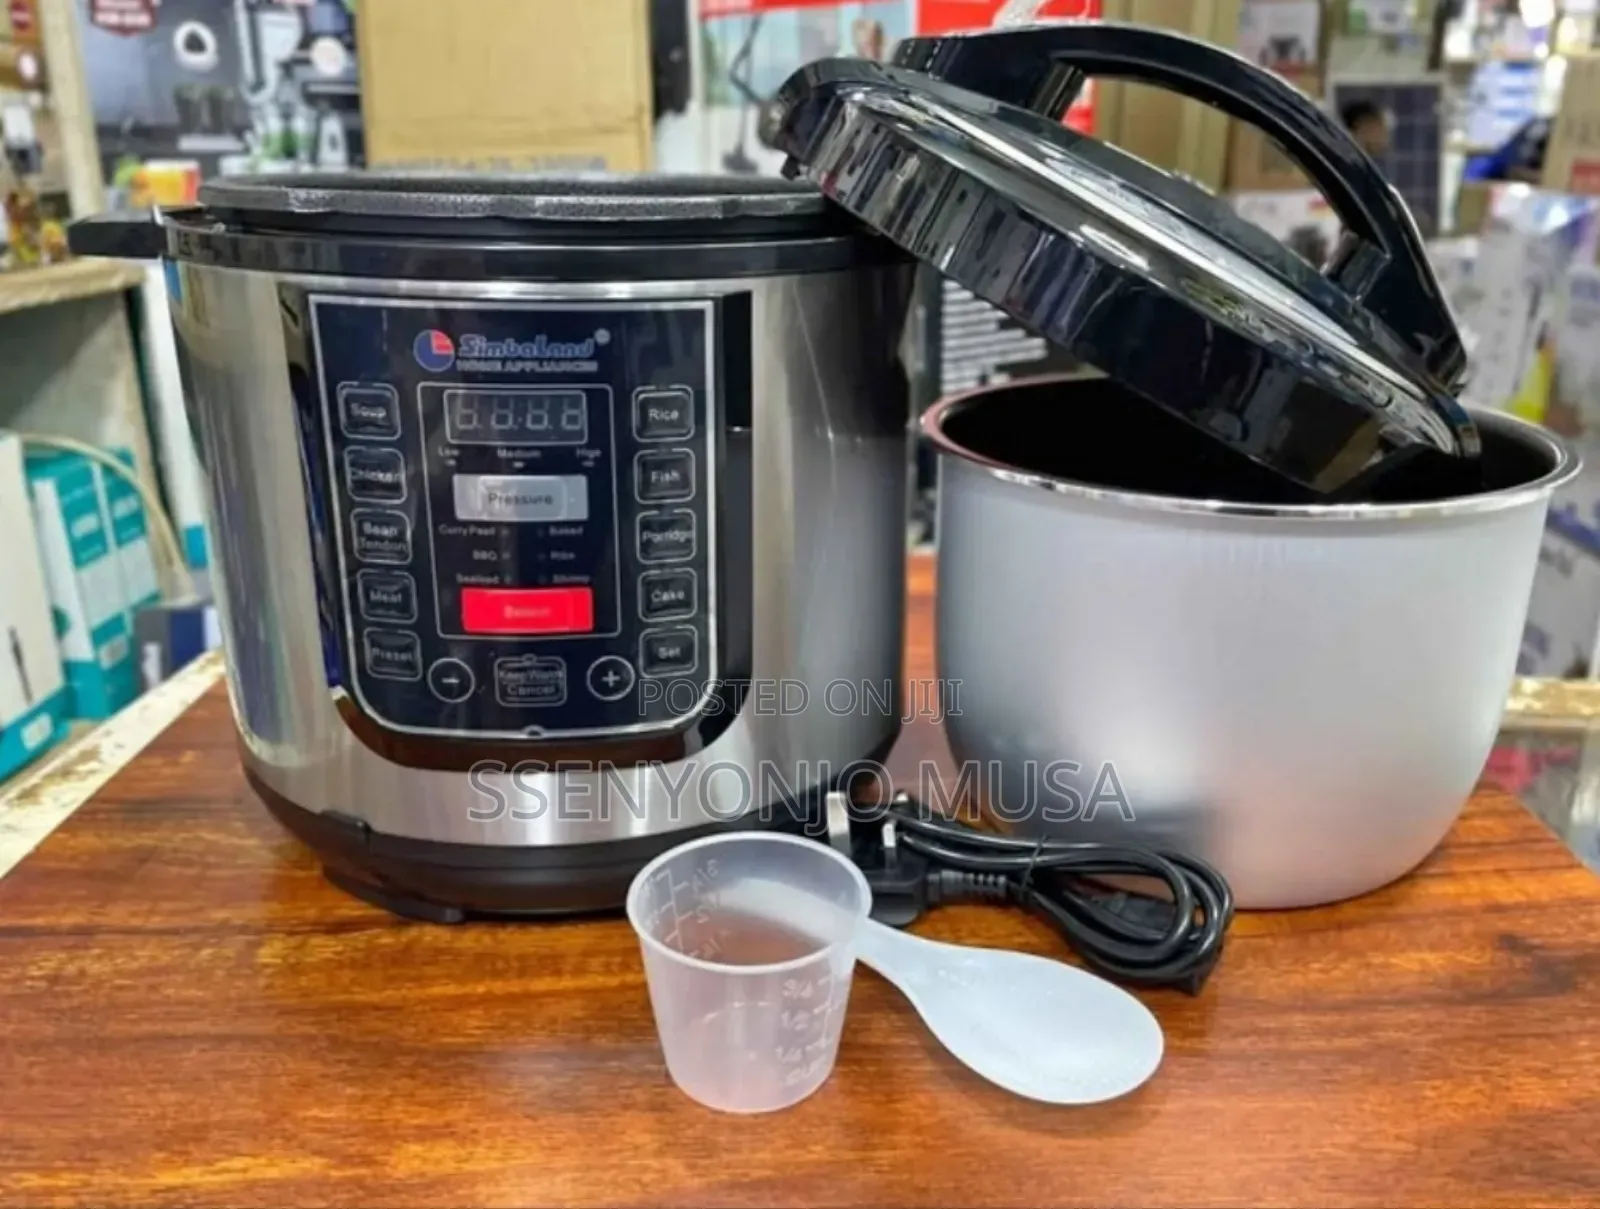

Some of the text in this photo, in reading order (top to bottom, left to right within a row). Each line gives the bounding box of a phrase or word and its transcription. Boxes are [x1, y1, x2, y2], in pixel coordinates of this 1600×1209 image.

[648, 408, 680, 422] Rice
[651, 470, 681, 484] Fish
[488, 493, 555, 506] Pressure
[651, 589, 686, 603] Cake
[657, 647, 681, 660] Set
